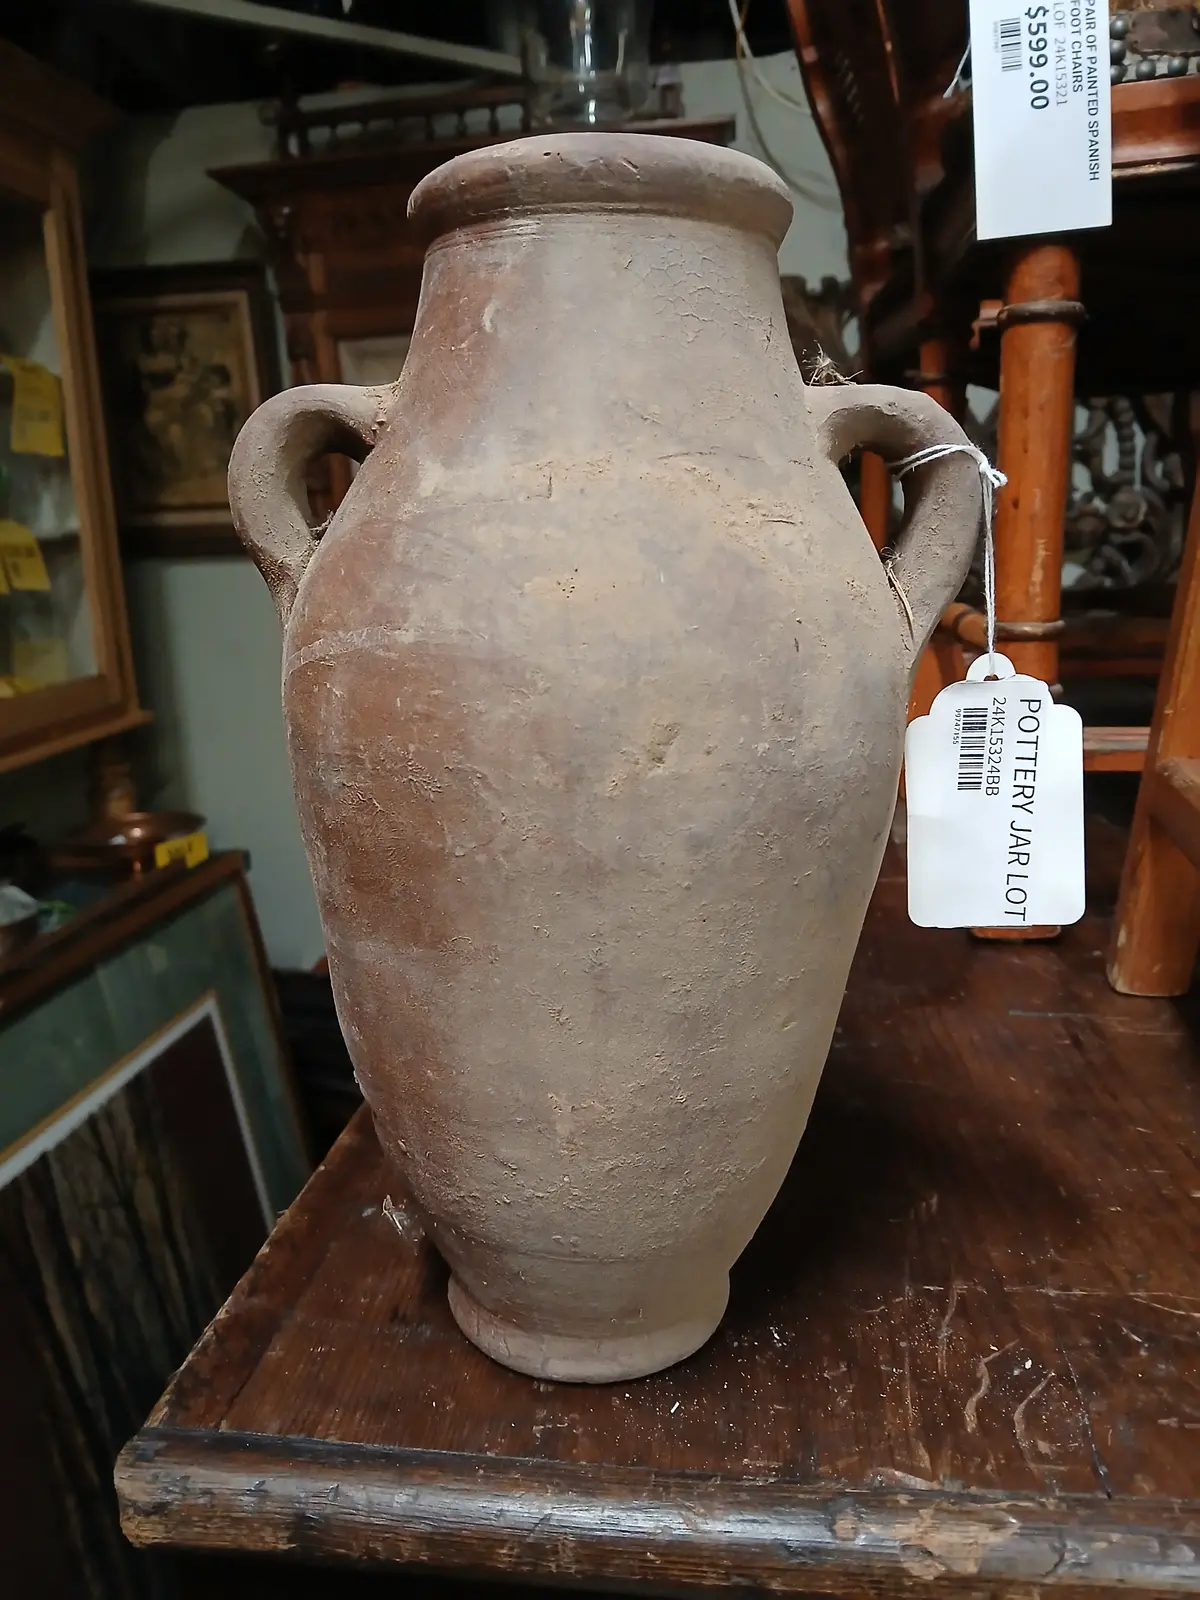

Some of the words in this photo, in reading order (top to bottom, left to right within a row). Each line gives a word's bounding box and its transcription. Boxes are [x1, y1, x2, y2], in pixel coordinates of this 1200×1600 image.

[1070, 0, 1082, 36] FOOT
[1084, 0, 1096, 31] PAIR
[1024, 5, 1050, 110] $599.00
[1071, 41, 1083, 93] CHAIRS
[1086, 34, 1097, 52] OF
[1054, 38, 1068, 107] 24K15321
[1087, 56, 1099, 116] PAINTED
[1088, 120, 1100, 181] SPANISH
[952, 708, 961, 745] 99747155
[985, 697, 1007, 796] 24K15324BB
[1012, 699, 1042, 814] POTTERY
[1007, 820, 1032, 866] JAR
[1004, 873, 1028, 921] LOT
